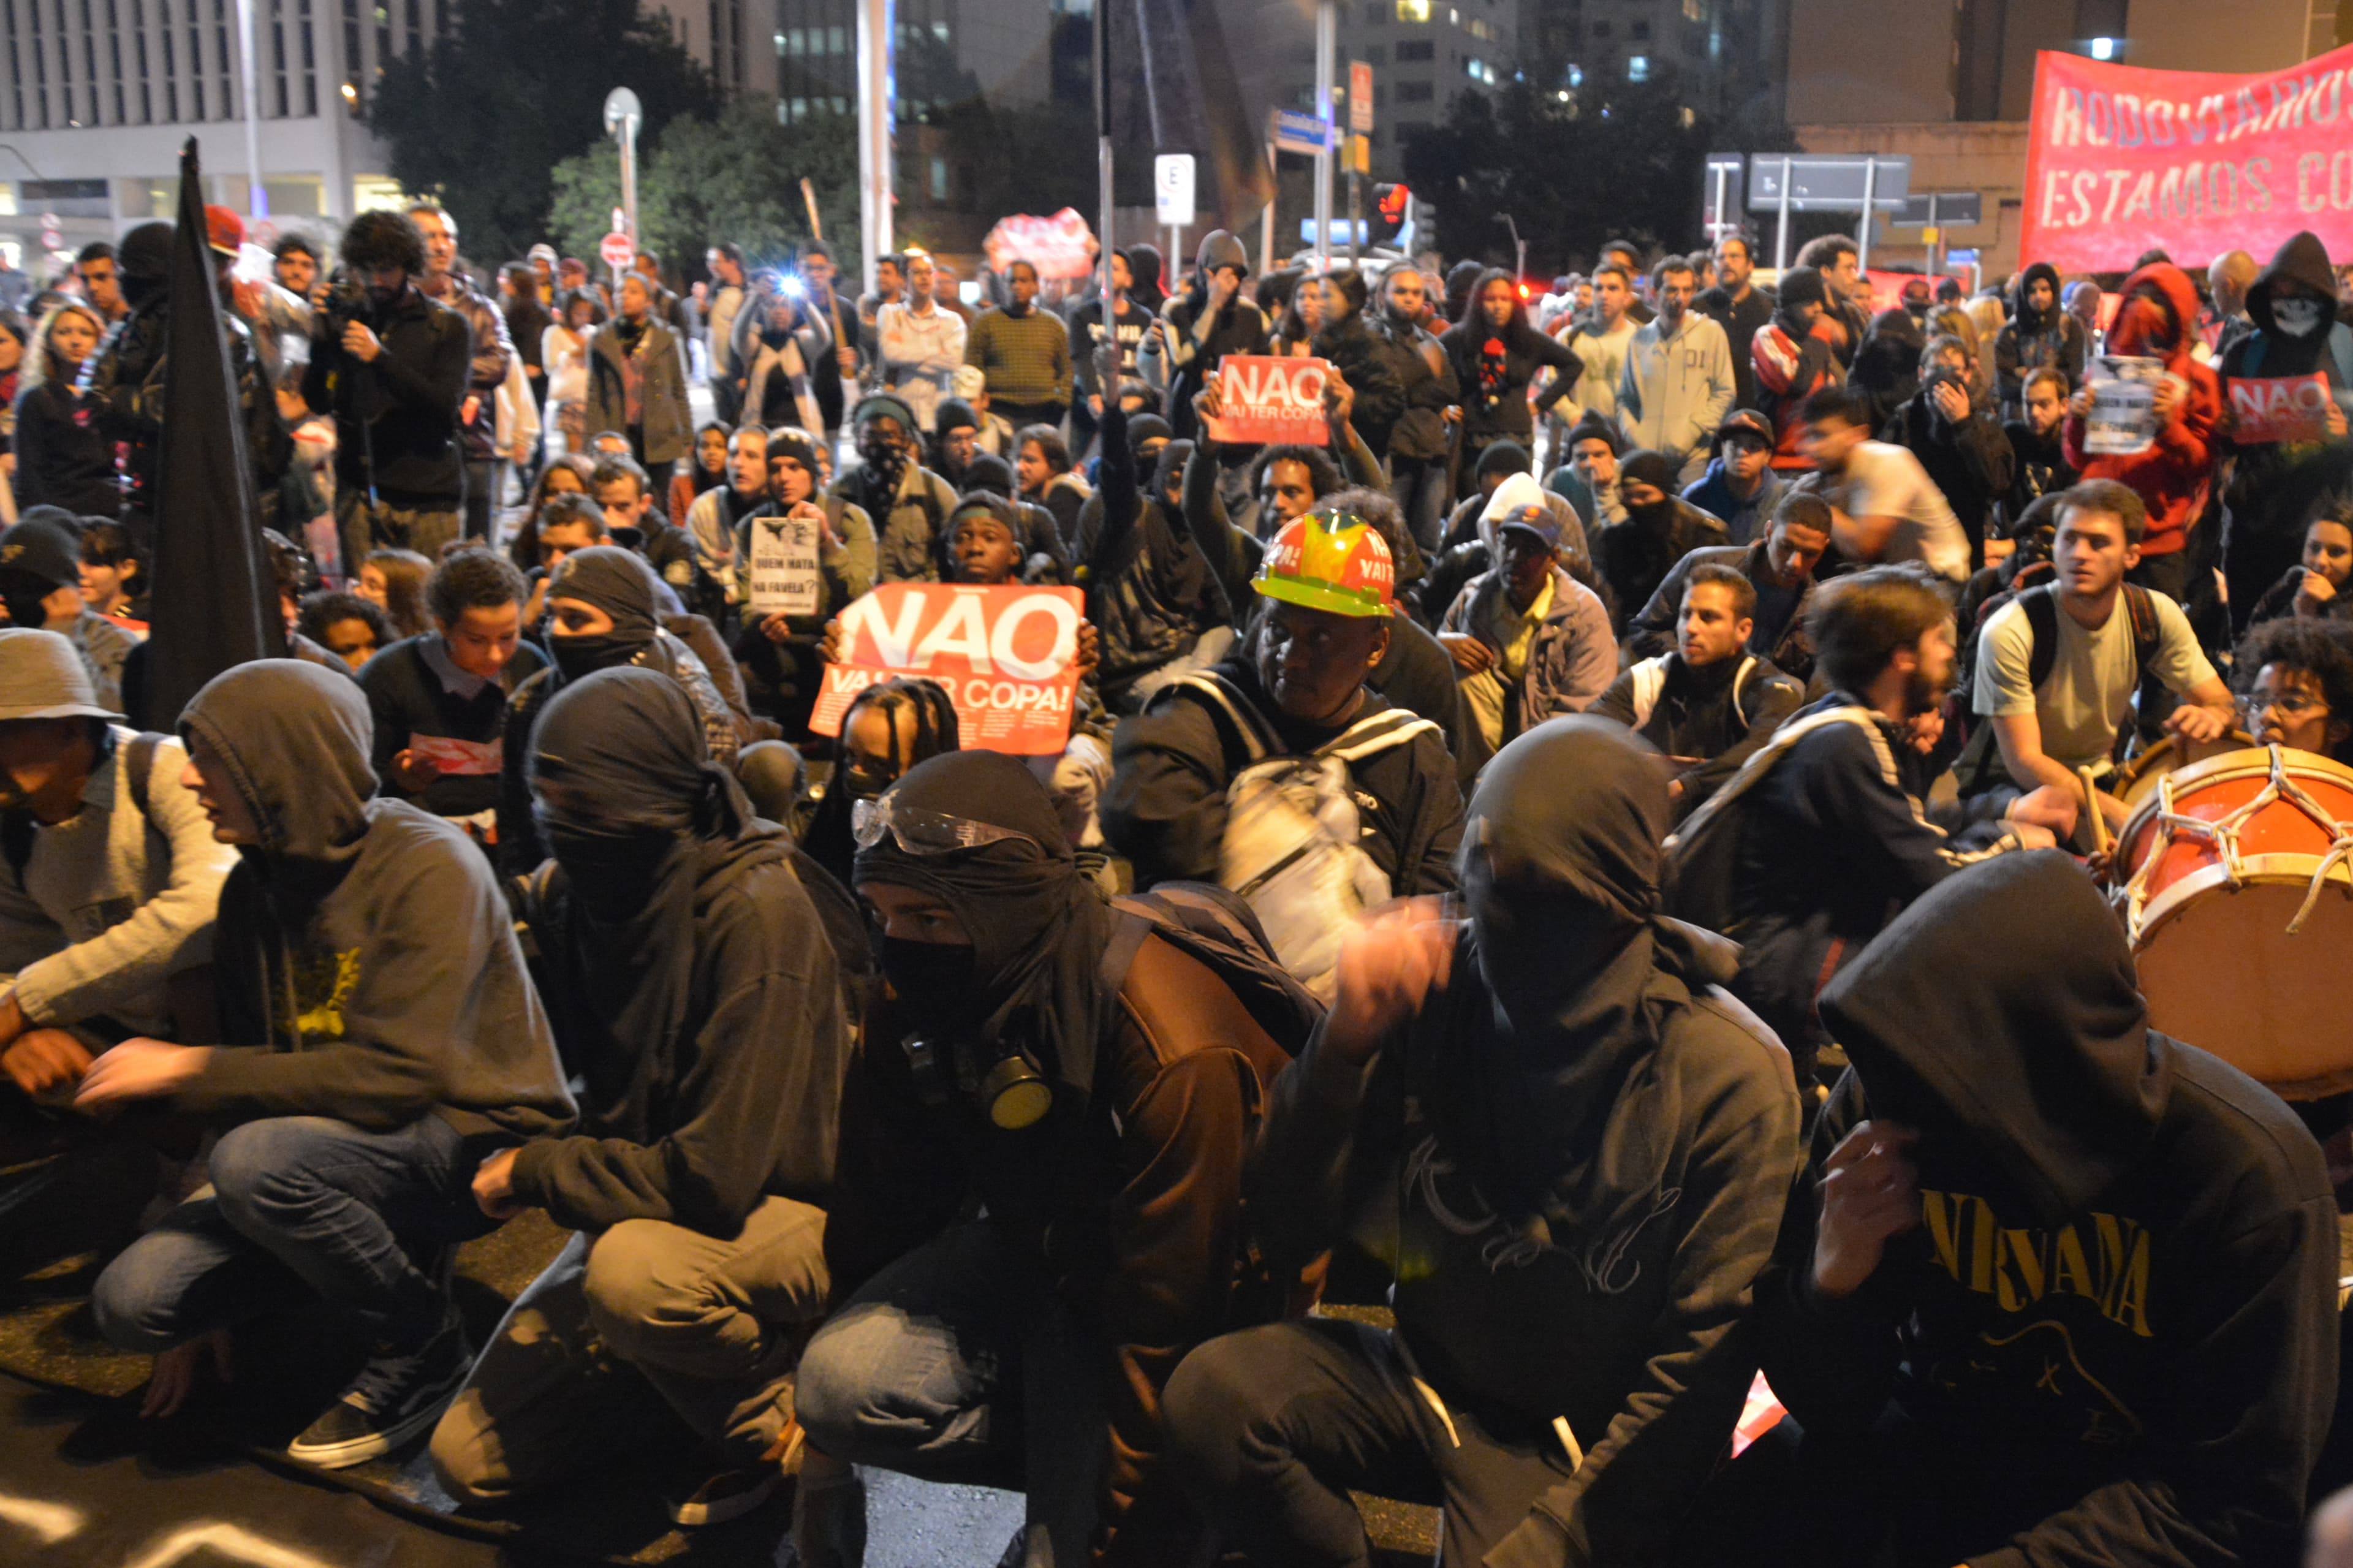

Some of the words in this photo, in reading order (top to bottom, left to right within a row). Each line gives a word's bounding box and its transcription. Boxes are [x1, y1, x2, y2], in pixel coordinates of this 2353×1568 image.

[2052, 72, 2353, 146] RODOVIARIO
[1169, 166, 1178, 185] E
[2042, 156, 2272, 228] ESTAMOS
[1222, 361, 1327, 407] NÃO
[1250, 406, 1278, 419] TER
[1360, 558, 1385, 582] VAI
[837, 587, 1078, 681] NÃO
[964, 678, 1070, 711] COPA!
[1920, 1187, 2154, 1337] NIRVANA
